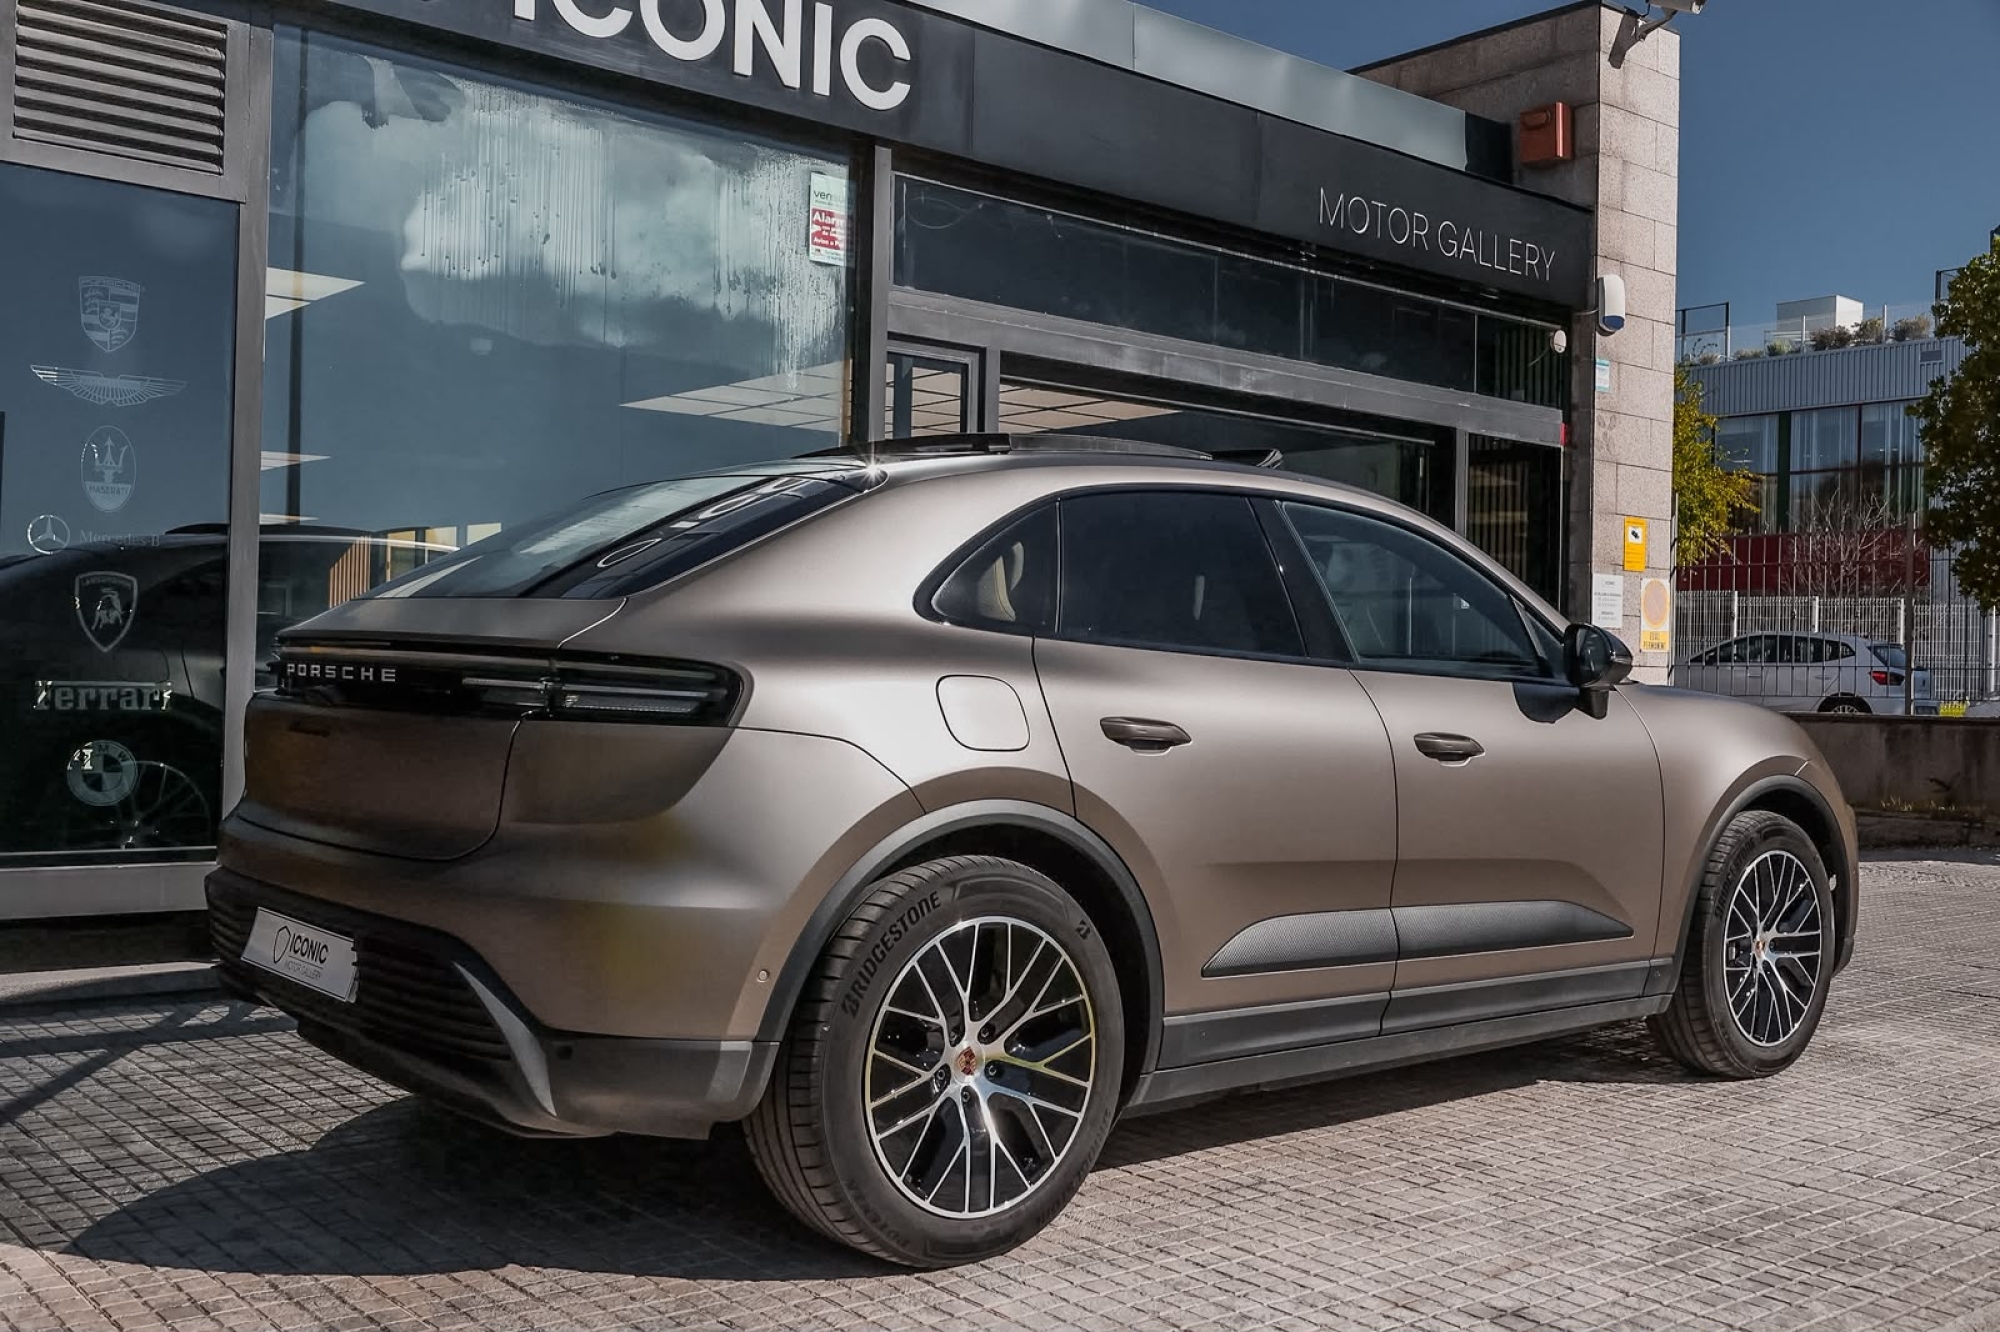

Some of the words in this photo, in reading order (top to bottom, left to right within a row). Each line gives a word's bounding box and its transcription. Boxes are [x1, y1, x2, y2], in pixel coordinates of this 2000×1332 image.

[514, 0, 912, 112] ONIC
[1319, 186, 1429, 251] MOTOR
[1438, 220, 1556, 281] GALLERY
[79, 529, 160, 548] Mercedes-B
[286, 663, 396, 682] PORSCHE
[34, 680, 172, 711] Ferrari
[289, 932, 329, 964] ICONIC
[841, 890, 941, 1019] BRIDGESTONE
